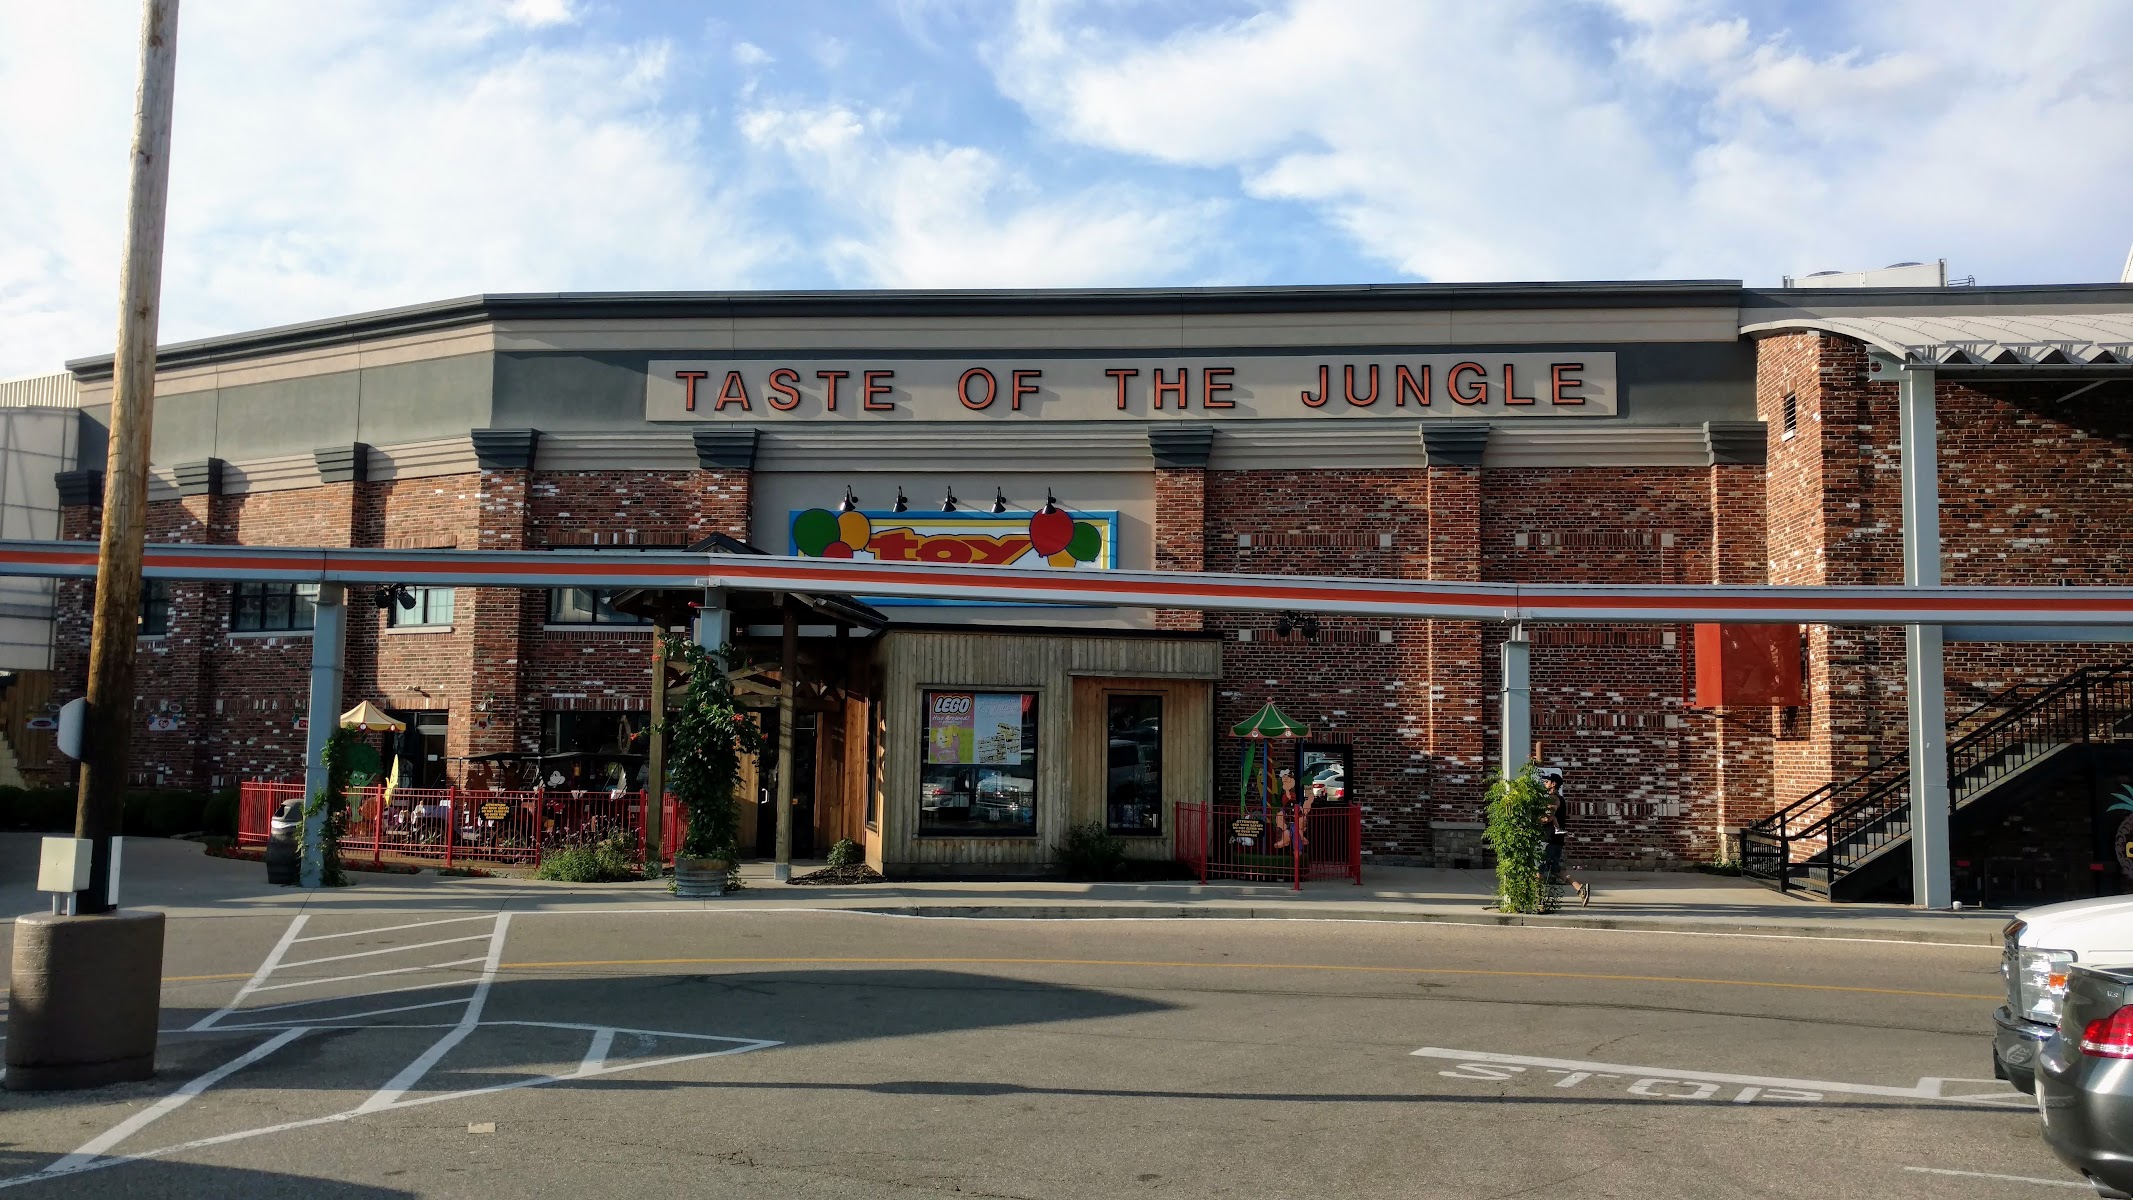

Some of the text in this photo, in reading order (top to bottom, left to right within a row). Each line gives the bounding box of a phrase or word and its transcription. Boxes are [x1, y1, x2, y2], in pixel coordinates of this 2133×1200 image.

[675, 361, 1586, 412] TASTE OF THE JUNGLE
[933, 696, 971, 714] LEGO
[1437, 1061, 1824, 1104] STOP
